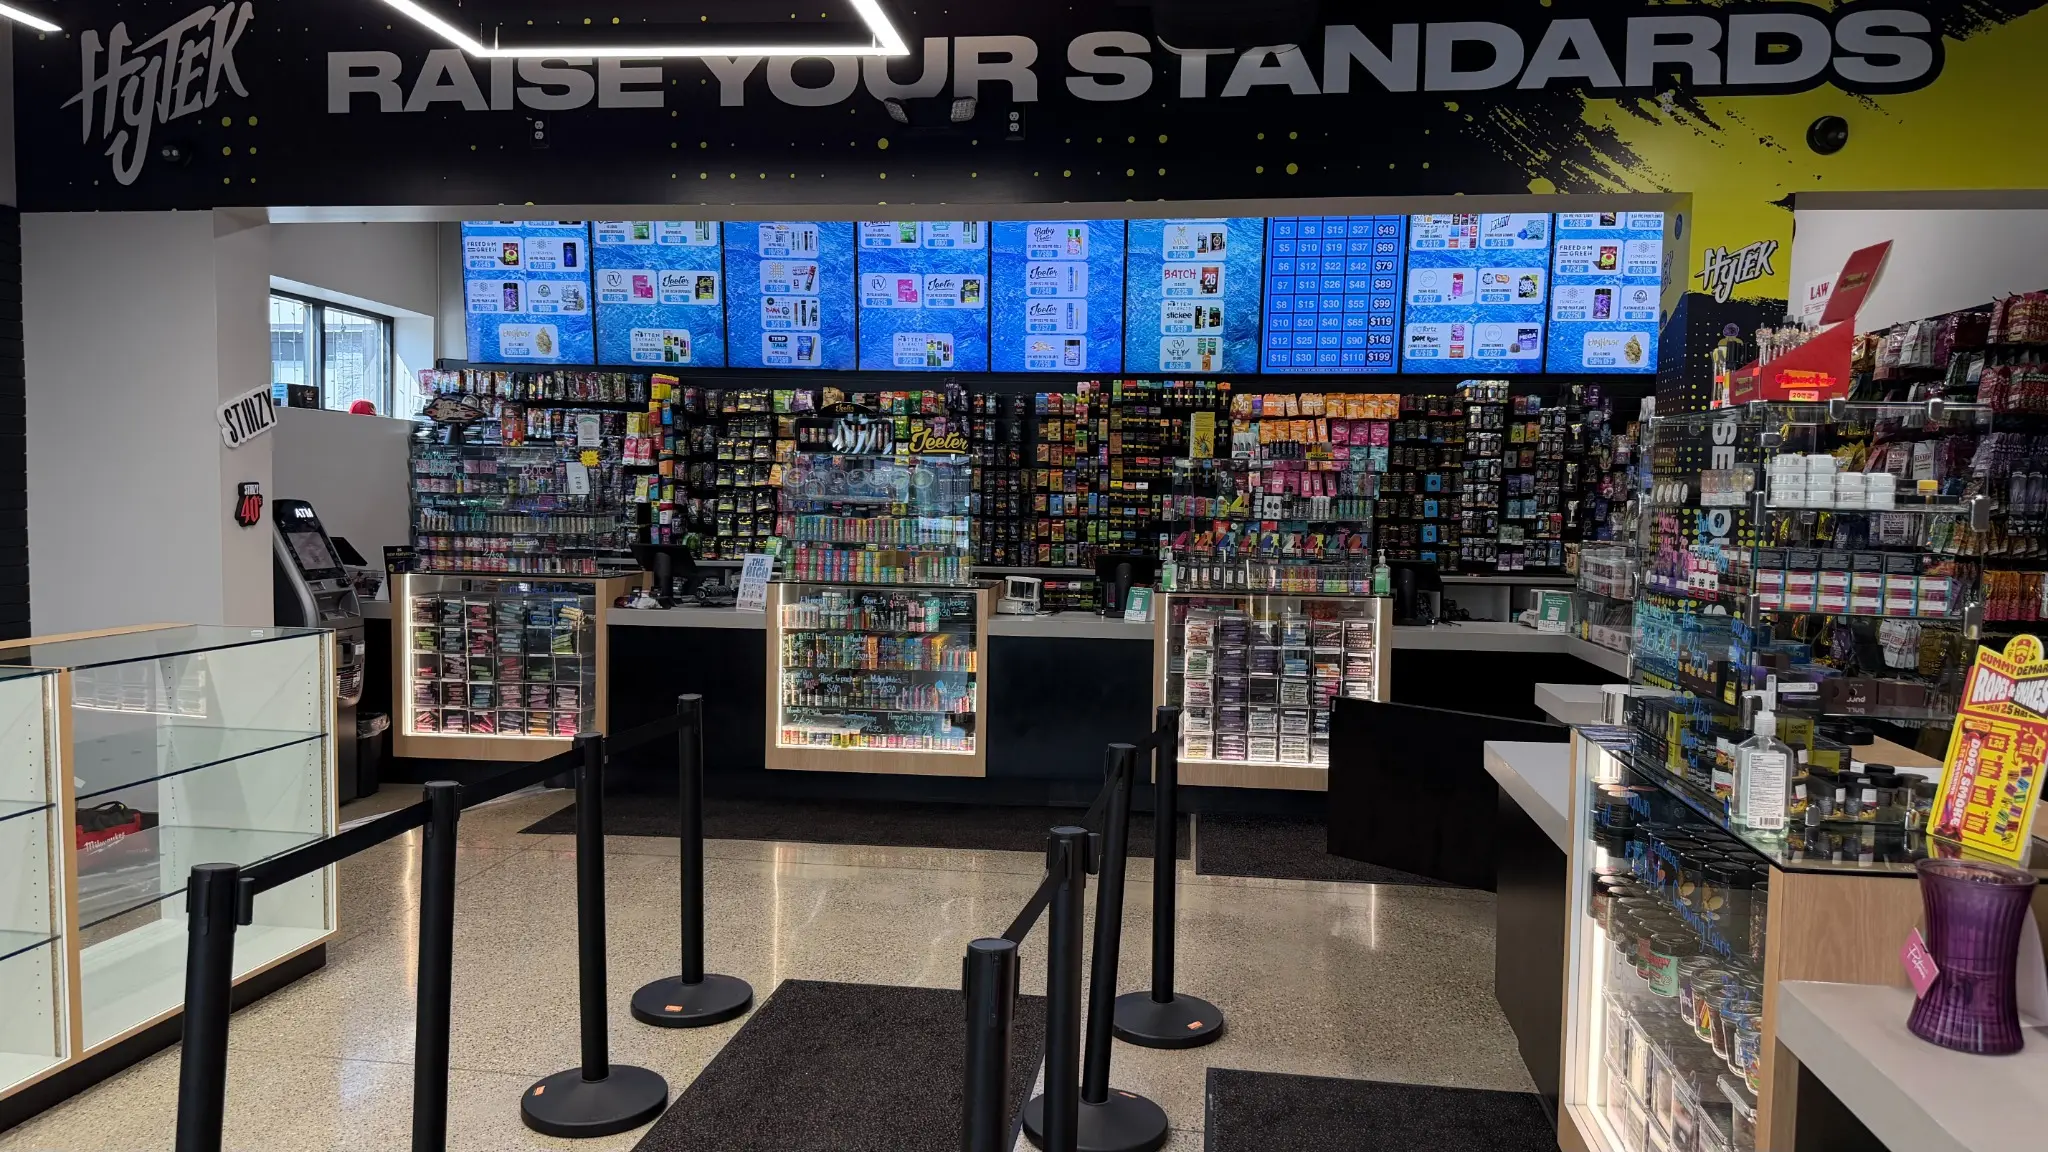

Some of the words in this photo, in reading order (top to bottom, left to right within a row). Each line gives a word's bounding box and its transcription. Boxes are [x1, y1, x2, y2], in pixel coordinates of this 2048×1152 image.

[328, 48, 664, 114] RAISE
[702, 36, 1038, 107] YOUR
[1066, 10, 1932, 101] STANDARDS
[1305, 226, 1315, 234] $8
[1327, 226, 1343, 234] $15
[1353, 226, 1368, 234] $27
[1378, 226, 1394, 236] $49
[1301, 244, 1317, 252] $10
[1326, 244, 1342, 252] $19
[1377, 244, 1393, 253] $69
[1279, 263, 1289, 271] $6
[1351, 262, 1366, 270] $42
[1376, 262, 1392, 271] $79
[1030, 265, 1058, 280] Jeeter
[1164, 268, 1197, 280] BATCH
[1300, 281, 1315, 289] $13
[1375, 280, 1391, 289] $89
[1810, 282, 1830, 300] LAW
[1030, 302, 1058, 316] Jeeter
[1276, 301, 1286, 309] $8
[1298, 300, 1314, 308] $15
[1323, 300, 1339, 308] $30
[1348, 300, 1364, 308] $55
[1374, 299, 1390, 309] $99
[1273, 319, 1288, 327] $10
[1298, 319, 1313, 327] $20
[1322, 318, 1338, 326] $40
[1370, 318, 1392, 326] $119
[1272, 337, 1288, 345] $12
[1369, 335, 1391, 345] $149
[1272, 354, 1286, 362] $15
[1296, 354, 1311, 362] $30
[1368, 353, 1390, 362] $199
[909, 428, 968, 455] Jeeter
[295, 507, 314, 518] ATM
[752, 558, 764, 566] THE
[1980, 652, 2017, 675] GUMMY
[1971, 667, 2010, 702] ROPES
[2001, 703, 2014, 715] 25
